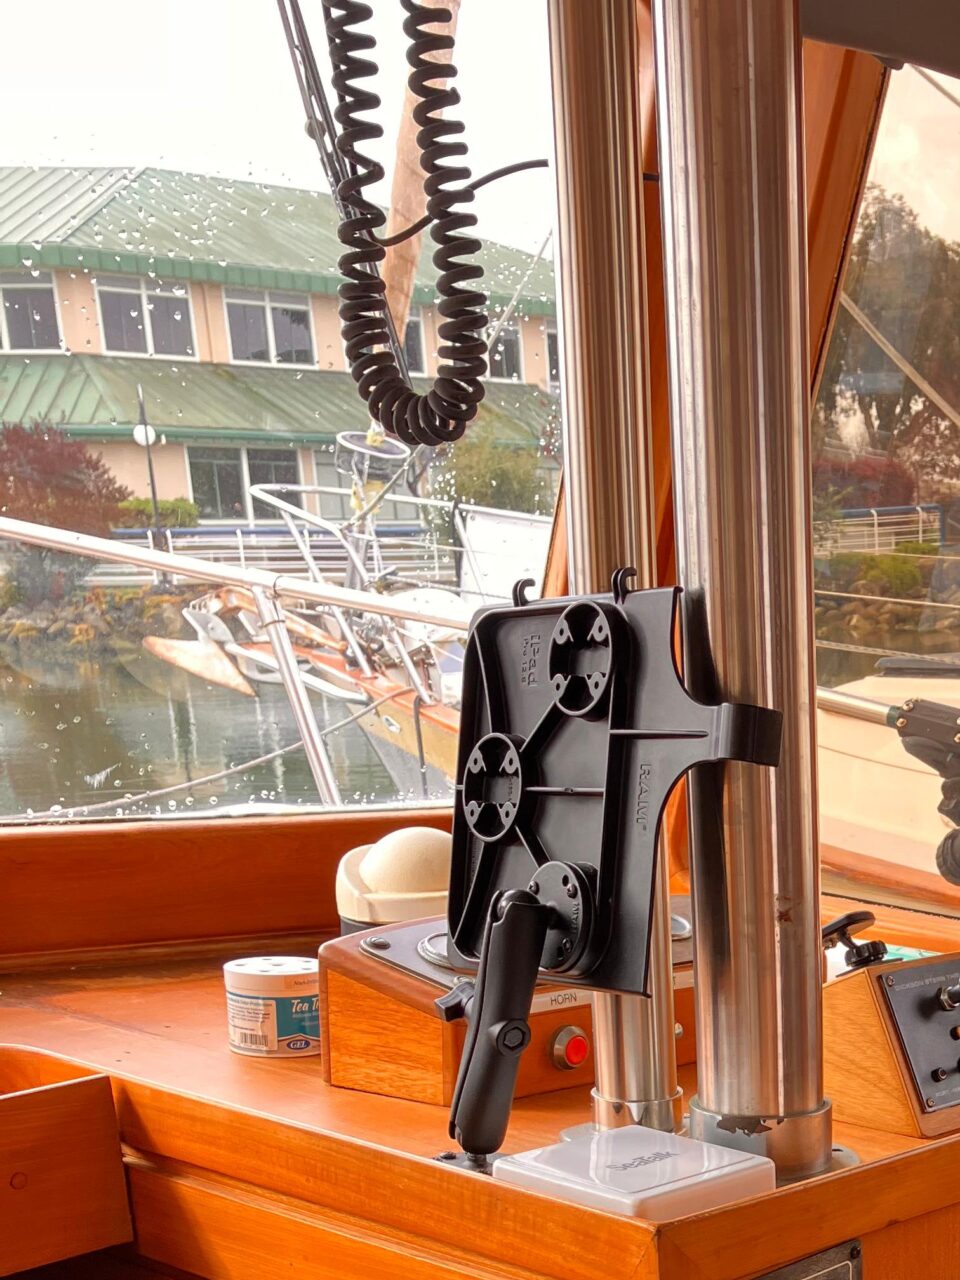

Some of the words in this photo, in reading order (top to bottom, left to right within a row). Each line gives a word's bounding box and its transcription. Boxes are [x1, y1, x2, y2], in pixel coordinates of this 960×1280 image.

[550, 991, 577, 1006] HORN
[290, 999, 310, 1013] Tea
[289, 1040, 308, 1050] GEL
[605, 1152, 681, 1171] SeaTalk
